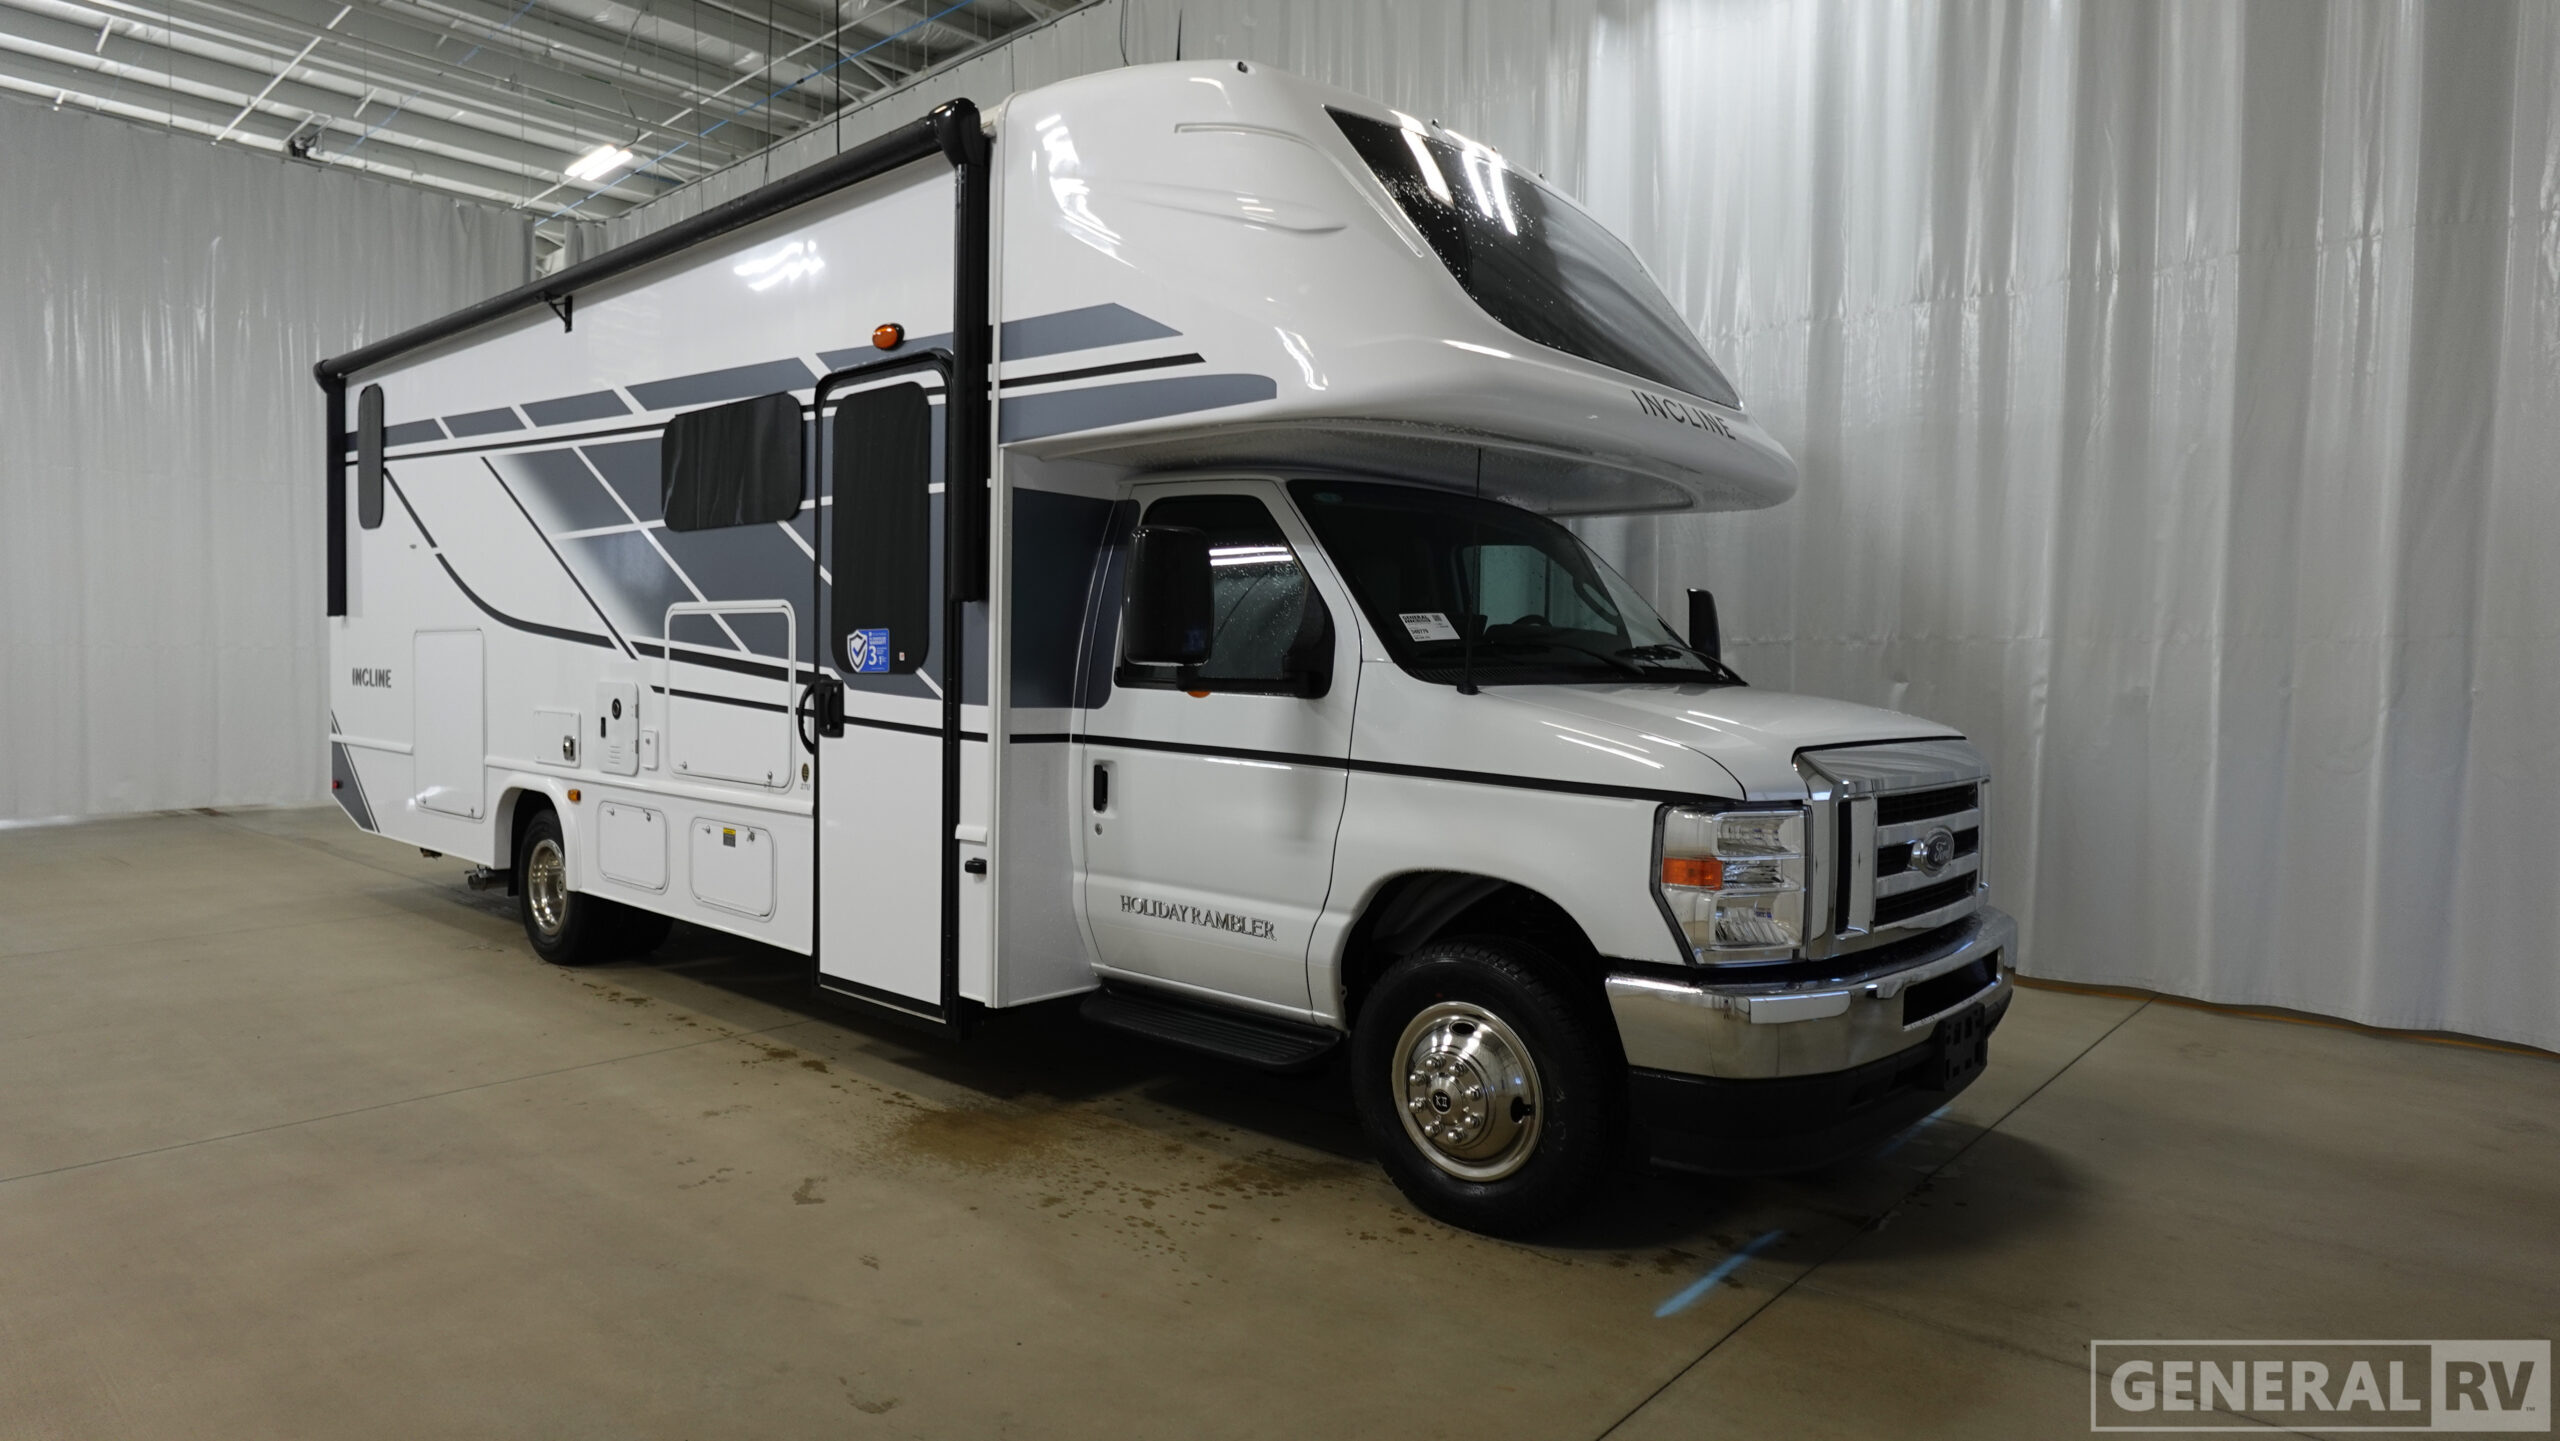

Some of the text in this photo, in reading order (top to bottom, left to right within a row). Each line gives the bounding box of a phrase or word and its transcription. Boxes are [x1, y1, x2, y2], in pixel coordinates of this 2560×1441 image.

[1631, 389, 1736, 440] INCLINE
[351, 667, 392, 688] INCLINE
[1120, 895, 1277, 941] HOLIDAY RAMBLER
